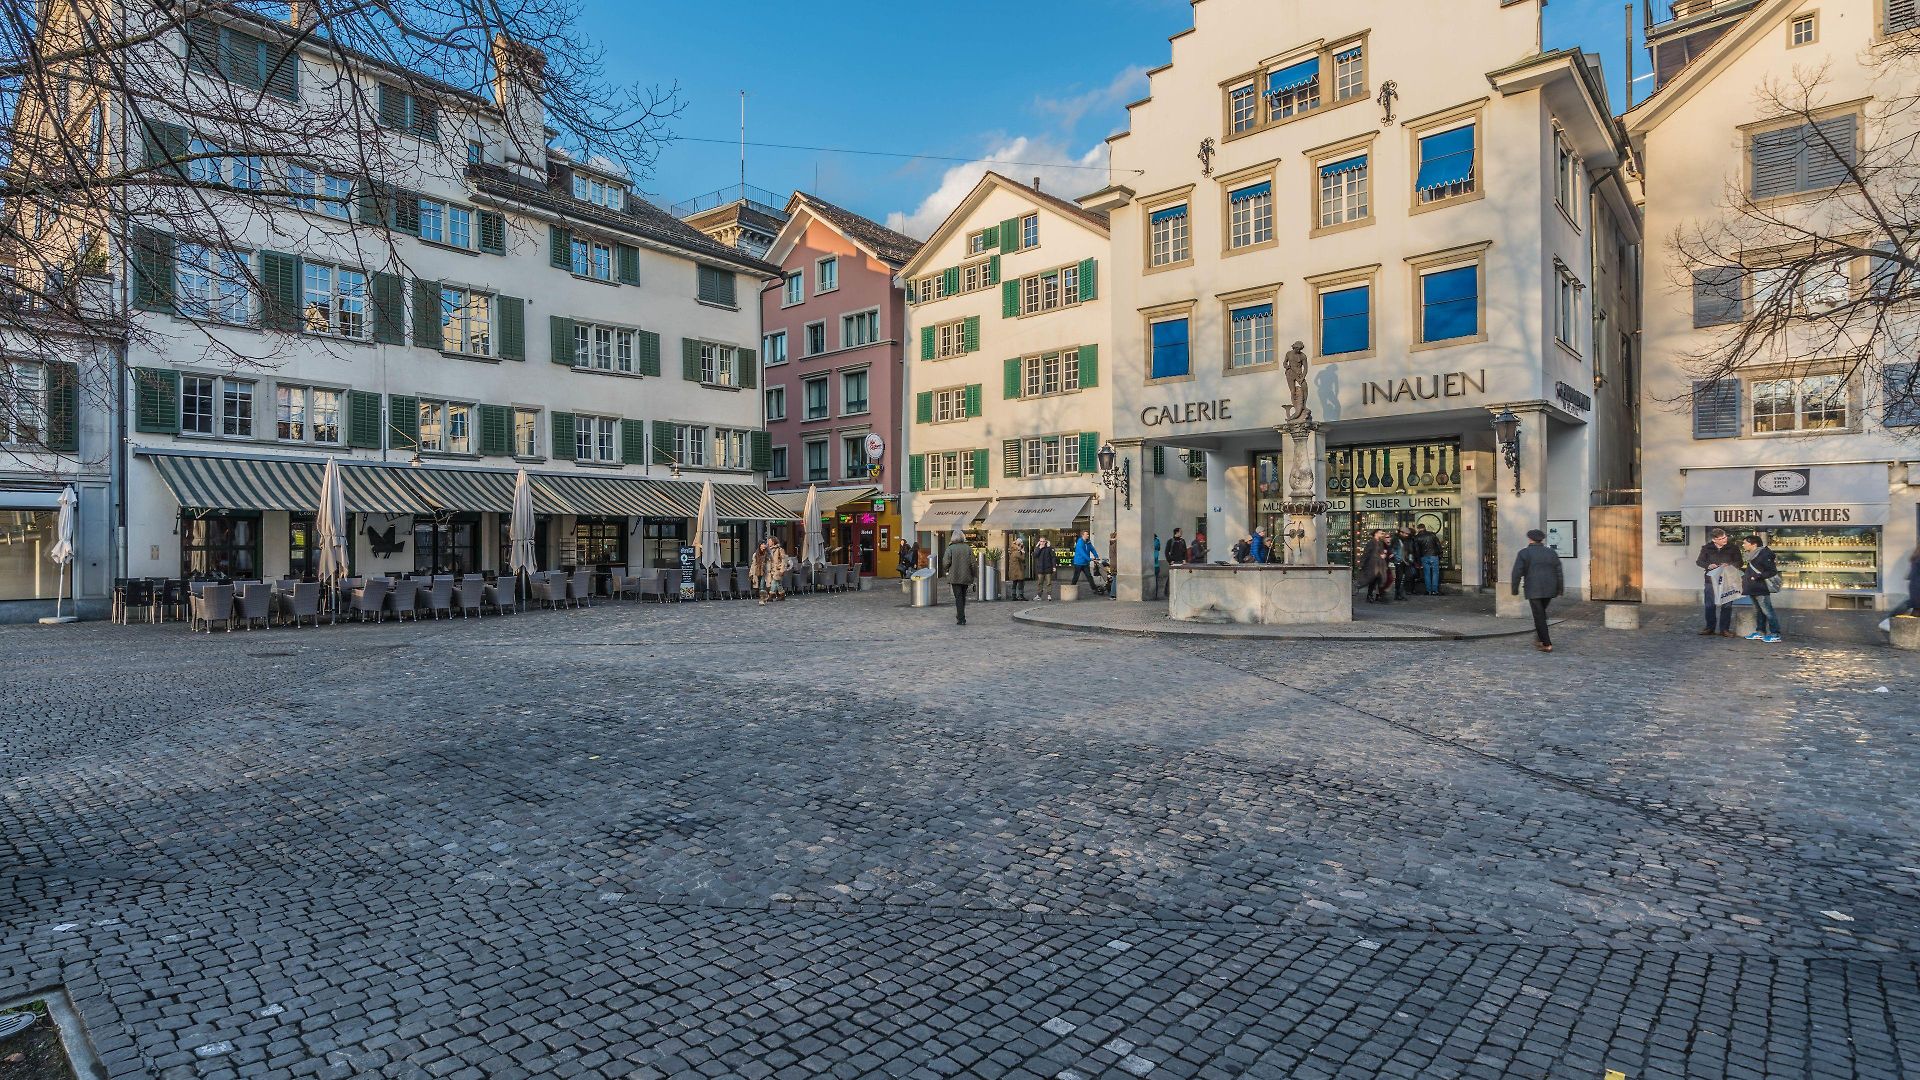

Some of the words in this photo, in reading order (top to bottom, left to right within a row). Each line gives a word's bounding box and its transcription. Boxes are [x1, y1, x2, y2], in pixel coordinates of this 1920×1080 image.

[1140, 399, 1232, 426] GALERIE
[1361, 369, 1485, 405] INAUEN
[1327, 500, 1346, 510] OLD
[1365, 499, 1400, 509] SILBER
[1408, 497, 1450, 508] UHREN
[1713, 510, 1763, 523] UHREN
[1779, 508, 1850, 522] WATCHES
